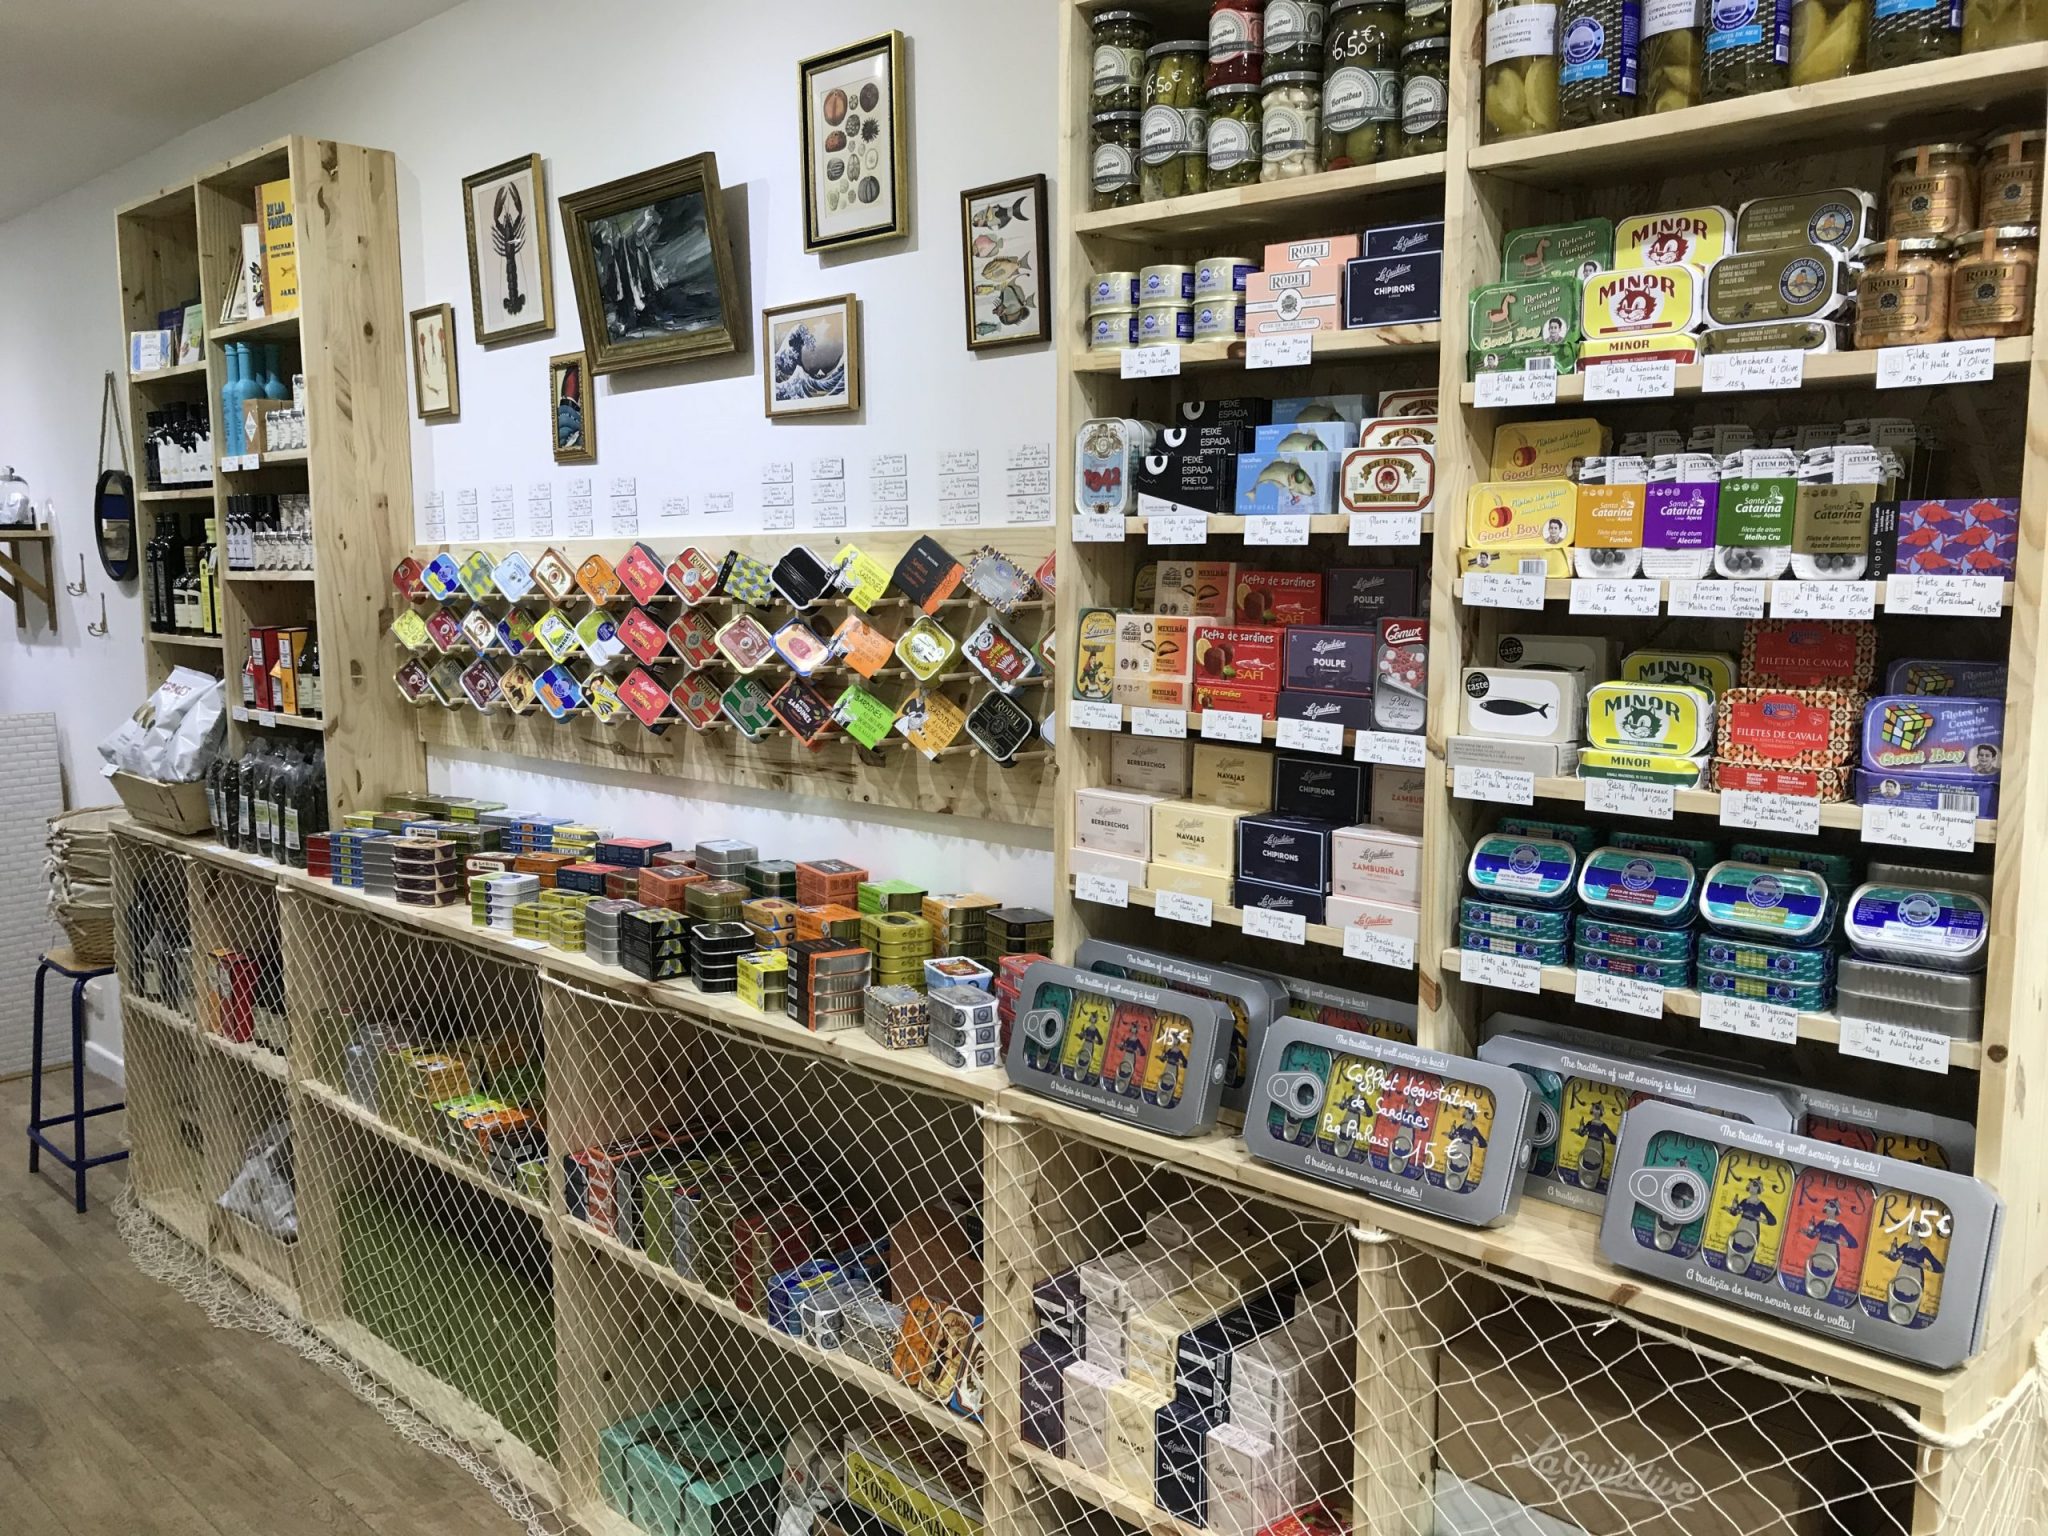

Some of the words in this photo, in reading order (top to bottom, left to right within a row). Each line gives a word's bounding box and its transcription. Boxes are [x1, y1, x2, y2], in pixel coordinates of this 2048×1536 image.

[1659, 8, 1692, 17] MAROCAINE
[1333, 25, 1376, 60] 6,50€
[1632, 217, 1708, 249] MINOR
[1374, 284, 1415, 296] CHIPIRONS
[1599, 274, 1675, 306] MINOR
[1480, 332, 1513, 350] Good
[1516, 324, 1541, 342] Boy
[1609, 339, 1650, 352] MINOR
[1958, 346, 1991, 356] Saumon
[1218, 409, 1248, 418] ESPADA
[1182, 456, 1204, 464] PEIXE
[1383, 459, 1408, 469] ROSE
[1182, 466, 1212, 475] ESPADA
[1502, 468, 1535, 481] Good
[1540, 463, 1563, 474] Boy
[1182, 477, 1208, 485] PRETO
[1744, 497, 1765, 505] Santa
[1592, 508, 1633, 517] Catarina
[1660, 506, 1703, 516] Catarina
[1735, 504, 1782, 513] Catarina
[1814, 510, 1861, 520] Catarina
[1478, 528, 1511, 542] Good
[1516, 524, 1540, 536] Boy
[1268, 577, 1278, 586] de
[1281, 576, 1316, 588] sardines
[1829, 584, 1838, 592] de
[1946, 579, 1955, 587] de
[1962, 579, 1986, 588] Thon
[1353, 595, 1385, 605] POULPE
[1977, 600, 2001, 613] 4,90€
[1201, 628, 1224, 640] Kefta
[1228, 632, 1238, 641] de
[1240, 631, 1274, 643] sardines
[1500, 646, 1522, 655] taste
[1313, 658, 1346, 668] POULPE
[1760, 656, 1795, 666] FILETES
[1799, 658, 1810, 666] DE
[1812, 658, 1849, 668] CAVALA
[1236, 669, 1264, 681] SAFI
[1638, 660, 1713, 683] MINOR
[1466, 680, 1489, 690] taste
[788, 698, 812, 724] SARDINES
[855, 695, 882, 718] SARDINES
[1604, 695, 1681, 723] MINOR
[1977, 706, 1989, 714] de
[928, 705, 957, 733] SARDINES
[1737, 728, 1771, 737] FILETES
[1774, 729, 1785, 738] DE
[1786, 731, 1824, 742] CAVALA
[1611, 755, 1651, 767] MINOR
[1880, 750, 1924, 766] Good
[1929, 748, 1966, 763] Boy
[1127, 759, 1166, 769] BERBERECHOS
[1217, 772, 1245, 782] NAVAJAS
[1298, 785, 1336, 797] CHIPIRONS
[1091, 818, 1130, 830] BERBERECHOS
[1176, 832, 1205, 844] NAVAJAS
[1262, 849, 1299, 862] CHIPIRONS
[1352, 862, 1405, 877] ZAMBURIÑAS
[1144, 991, 1159, 1001] back!
[1157, 1027, 1189, 1046] 15€
[1336, 1034, 1348, 1045] The
[1349, 1039, 1373, 1054] tradition
[1374, 1045, 1382, 1057] of
[1383, 1046, 1397, 1058] well
[1397, 1052, 1421, 1067] serving
[1421, 1056, 1429, 1066] is
[1429, 1055, 1449, 1069] back!
[1560, 1056, 1575, 1071] The
[1575, 1060, 1605, 1080] tradition
[1606, 1067, 1617, 1084] of
[1617, 1067, 1634, 1084] well
[1635, 1073, 1664, 1091] serving
[1664, 1081, 1672, 1093] is
[1672, 1081, 1696, 1096] back!
[1347, 1063, 1399, 1093] Coffret
[1403, 1080, 1481, 1114] dégustation
[1350, 1098, 1365, 1110] de
[1839, 1105, 1849, 1116] is
[1850, 1105, 1877, 1121] back!
[1444, 1138, 1464, 1160] €
[1720, 1124, 1739, 1140] The
[1739, 1128, 1774, 1150] tradition
[1774, 1139, 1786, 1156] of
[1786, 1140, 1807, 1158] well
[1807, 1146, 1841, 1167] serving
[1841, 1157, 1851, 1169] is
[1852, 1156, 1881, 1174] back!
[1313, 1157, 1336, 1173] tradição
[1336, 1164, 1346, 1175] de
[1347, 1166, 1360, 1178] bem
[1380, 1178, 1395, 1190] está
[1395, 1181, 1403, 1192] de
[1403, 1184, 1423, 1198] volta!
[1722, 1152, 1788, 1194] RIOS
[1799, 1170, 1868, 1214] RIOS
[1885, 1207, 1952, 1237] 15€
[1696, 1270, 1731, 1291] tradição
[1731, 1280, 1744, 1292] de
[1744, 1284, 1763, 1300] bem
[1763, 1296, 1791, 1312] servir
[1793, 1300, 1812, 1318] está
[1813, 1307, 1826, 1322] de
[1826, 1311, 1855, 1332] volta!
